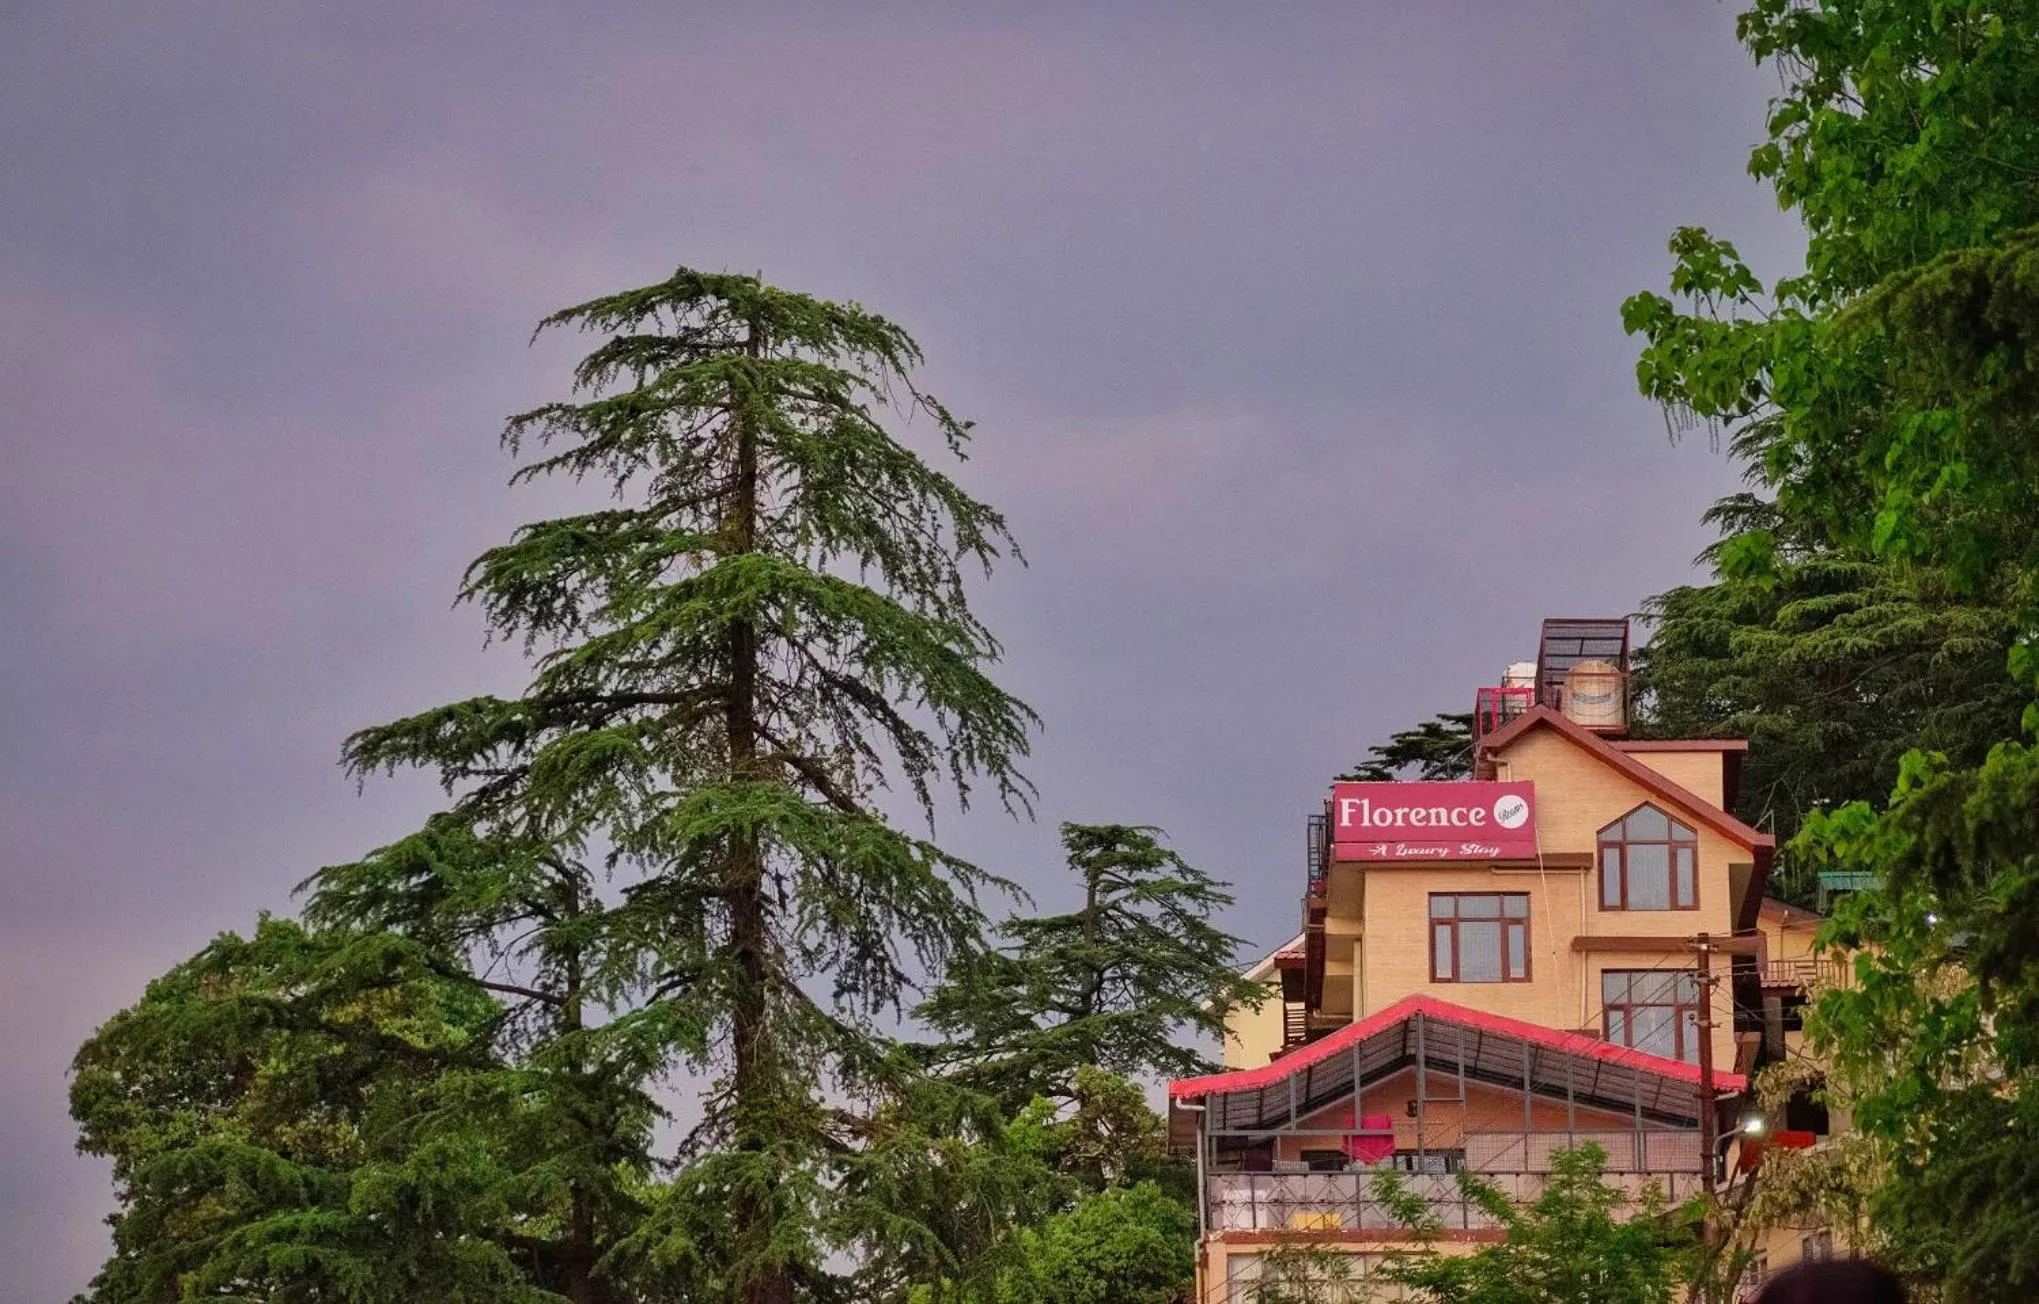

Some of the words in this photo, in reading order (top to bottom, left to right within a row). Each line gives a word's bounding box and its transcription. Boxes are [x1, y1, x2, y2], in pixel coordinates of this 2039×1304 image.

[1340, 798, 1486, 827] Florence
[1370, 844, 1388, 856] A
[1395, 844, 1449, 857] Luxury
[1460, 844, 1501, 857] Stay
